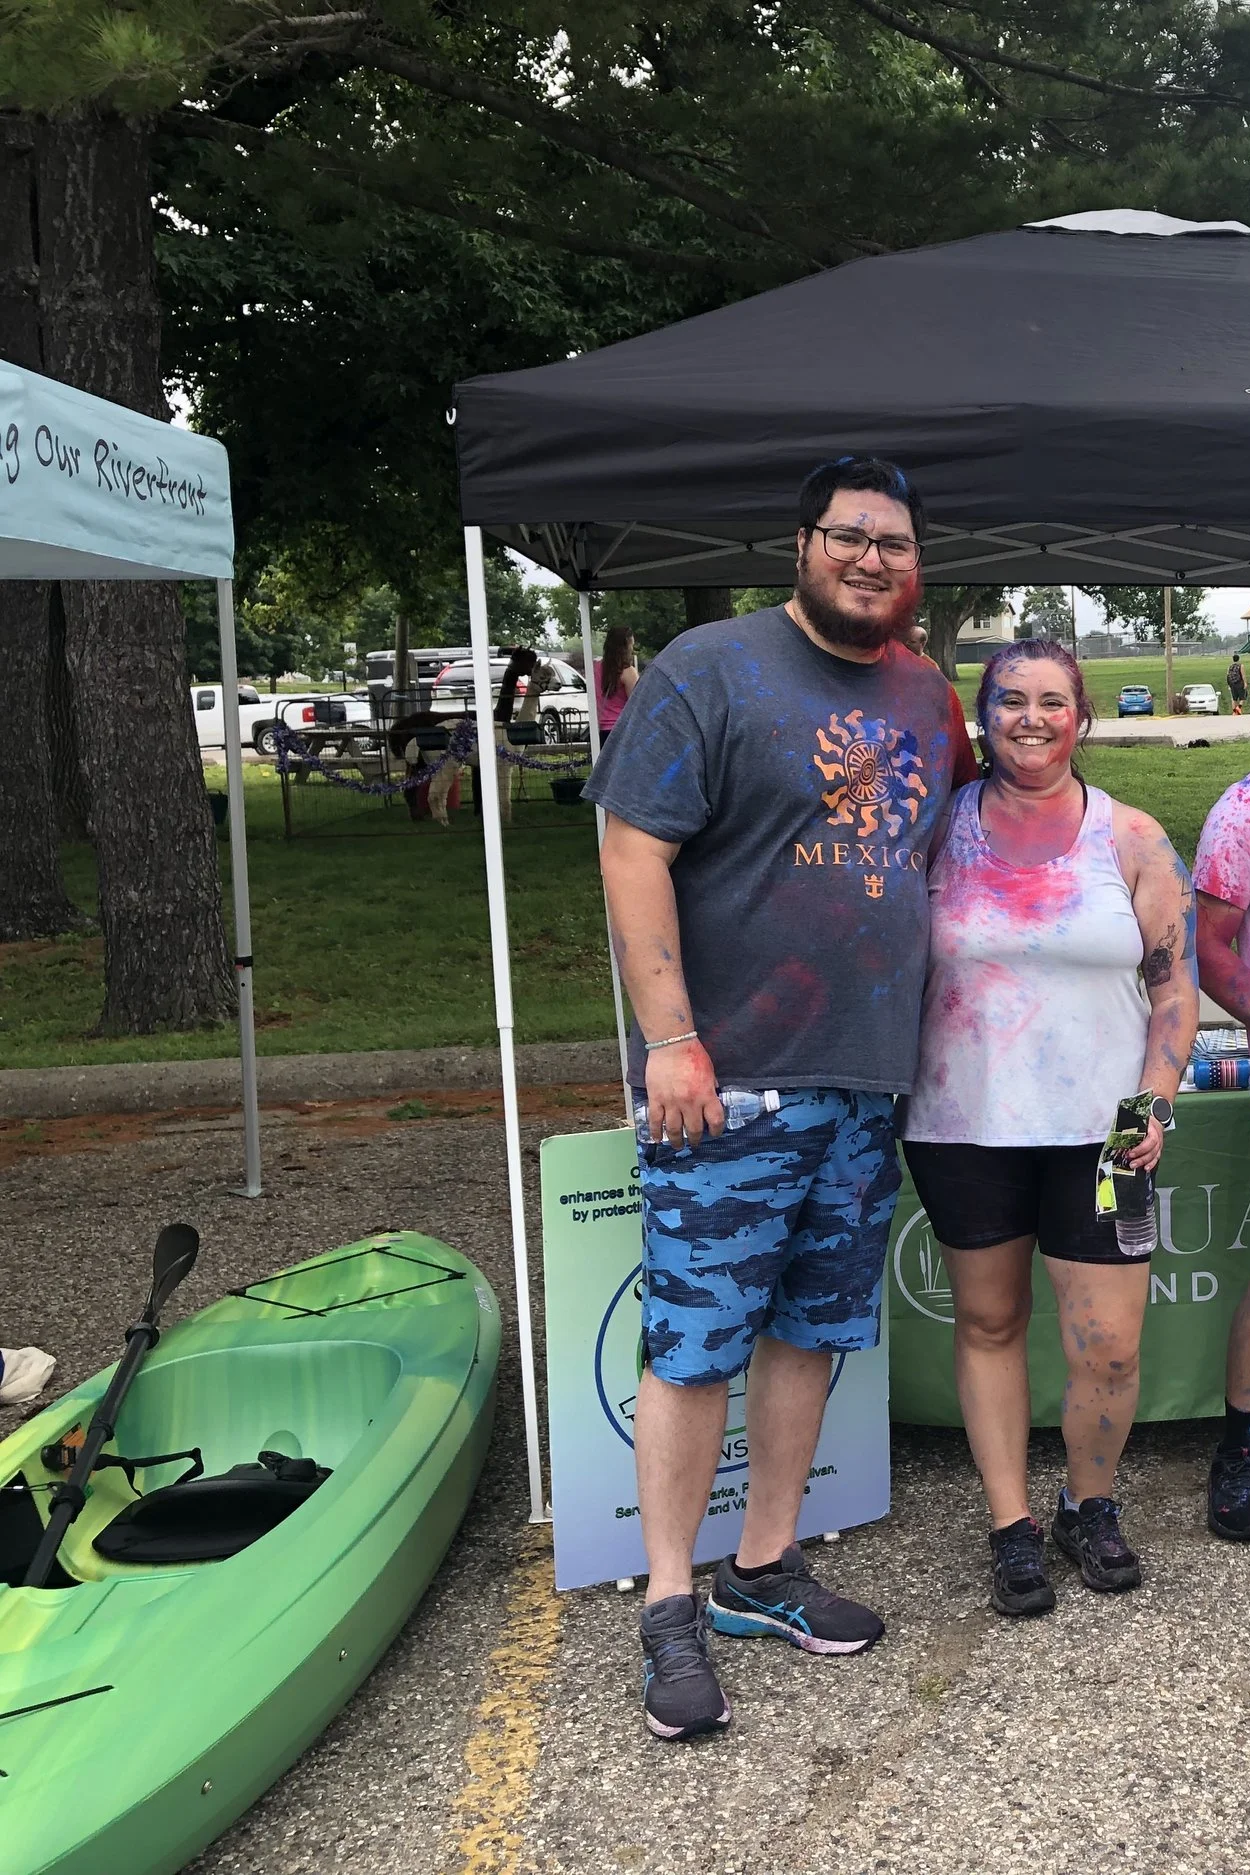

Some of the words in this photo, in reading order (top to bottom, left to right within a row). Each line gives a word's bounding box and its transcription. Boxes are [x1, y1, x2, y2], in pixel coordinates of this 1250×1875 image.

[34, 424, 81, 478] Our
[93, 438, 207, 516] Riverfront
[793, 842, 924, 872] MEXICO
[559, 1187, 625, 1205] enhances
[627, 1183, 643, 1197] th
[572, 1208, 589, 1223] by
[592, 1200, 643, 1222] protecti
[1150, 1271, 1219, 1305] ND
[709, 1486, 739, 1501] arke,
[708, 1501, 730, 1516] and
